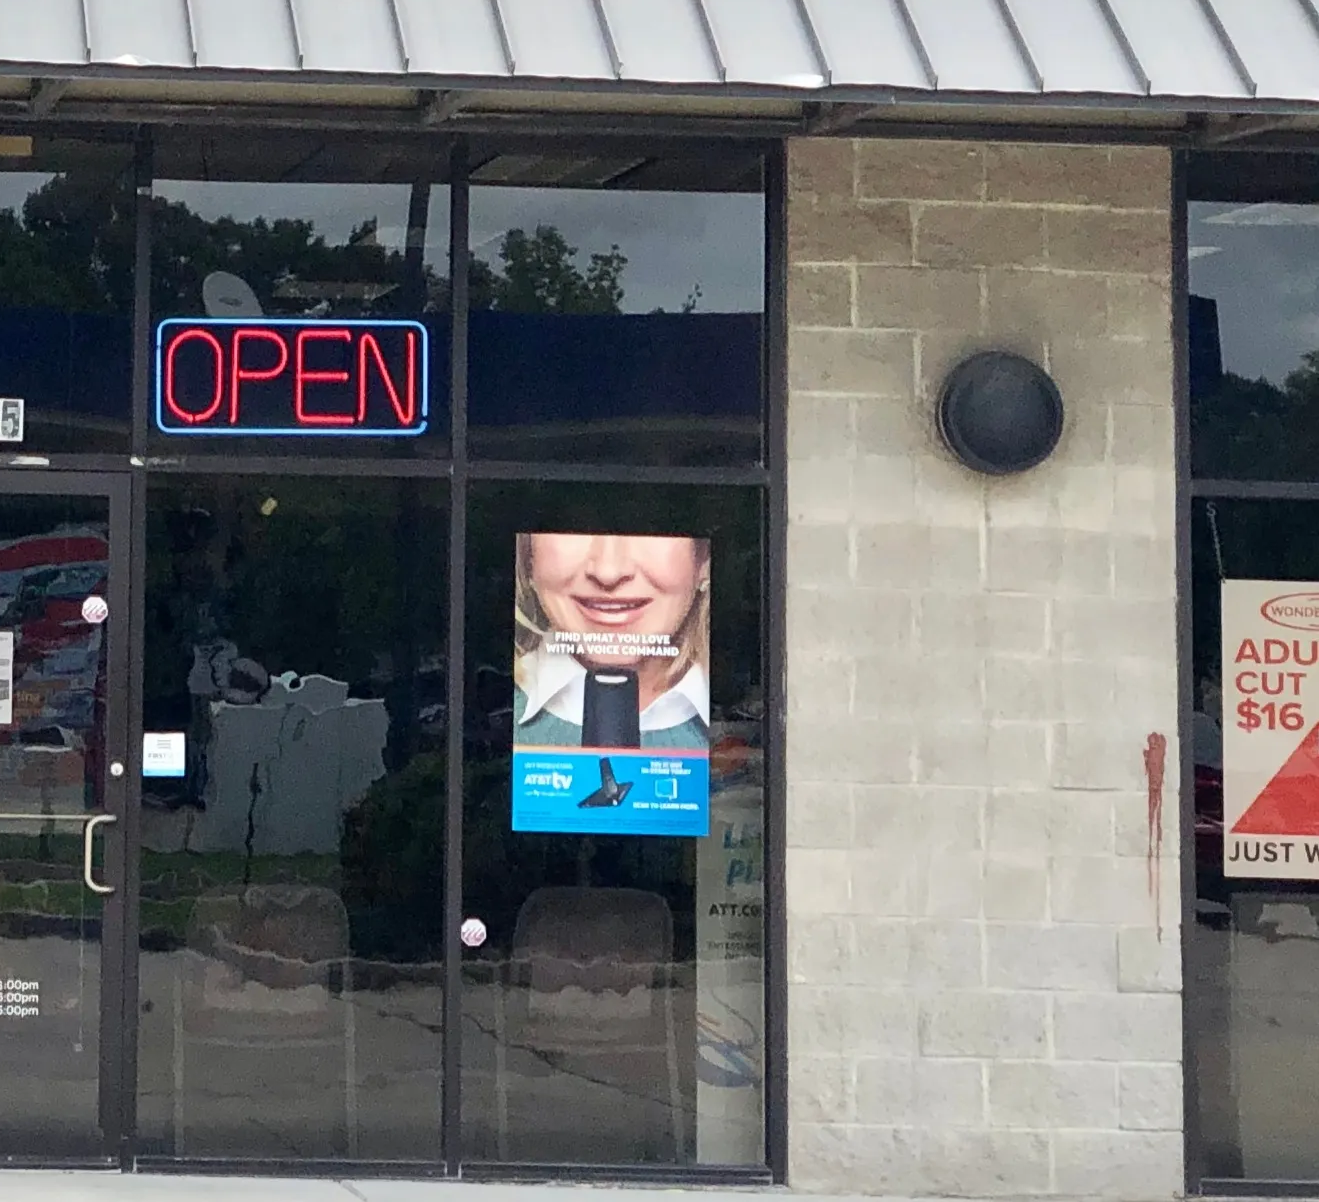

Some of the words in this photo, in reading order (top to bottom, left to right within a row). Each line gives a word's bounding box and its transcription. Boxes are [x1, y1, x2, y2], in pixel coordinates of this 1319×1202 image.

[165, 328, 416, 424] OPEN
[546, 643, 574, 654] WITH
[576, 644, 585, 654] A
[587, 645, 620, 655] VOICE
[622, 646, 680, 657] COMMAND
[555, 632, 580, 642] FIND
[582, 632, 614, 643] WHAT
[616, 633, 640, 643] YOU
[642, 634, 671, 645] LOVE
[1235, 671, 1307, 697] CUT
[1236, 697, 1305, 733] $16
[1229, 841, 1294, 865] JUST
